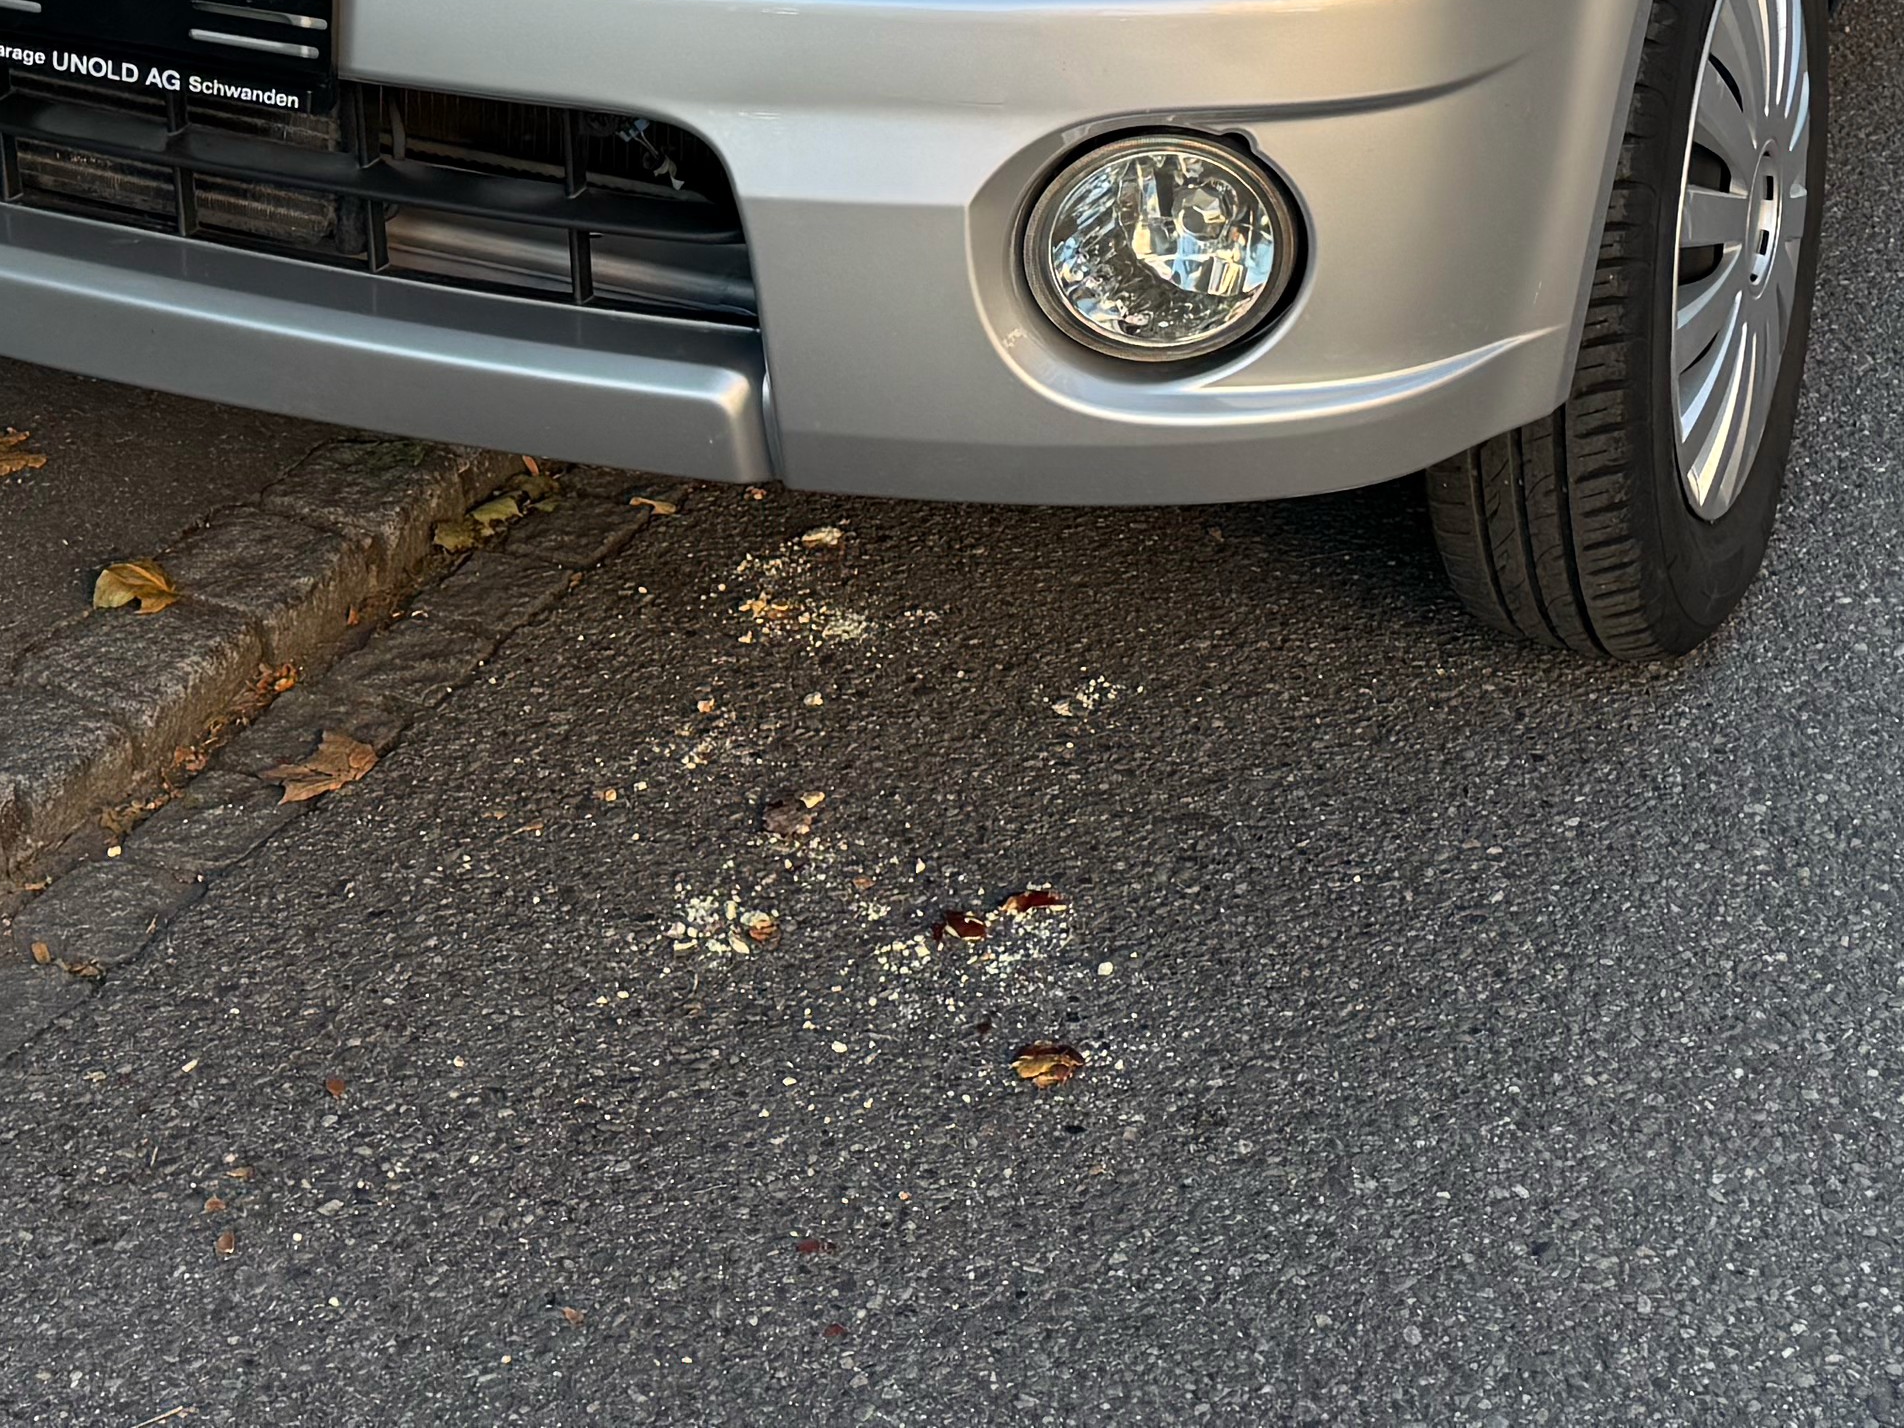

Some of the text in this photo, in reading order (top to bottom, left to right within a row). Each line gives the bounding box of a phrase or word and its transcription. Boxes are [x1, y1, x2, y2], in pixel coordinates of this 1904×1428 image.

[52, 50, 140, 84] UNOLD
[145, 66, 182, 92] AG
[188, 75, 300, 110] Schwanden
